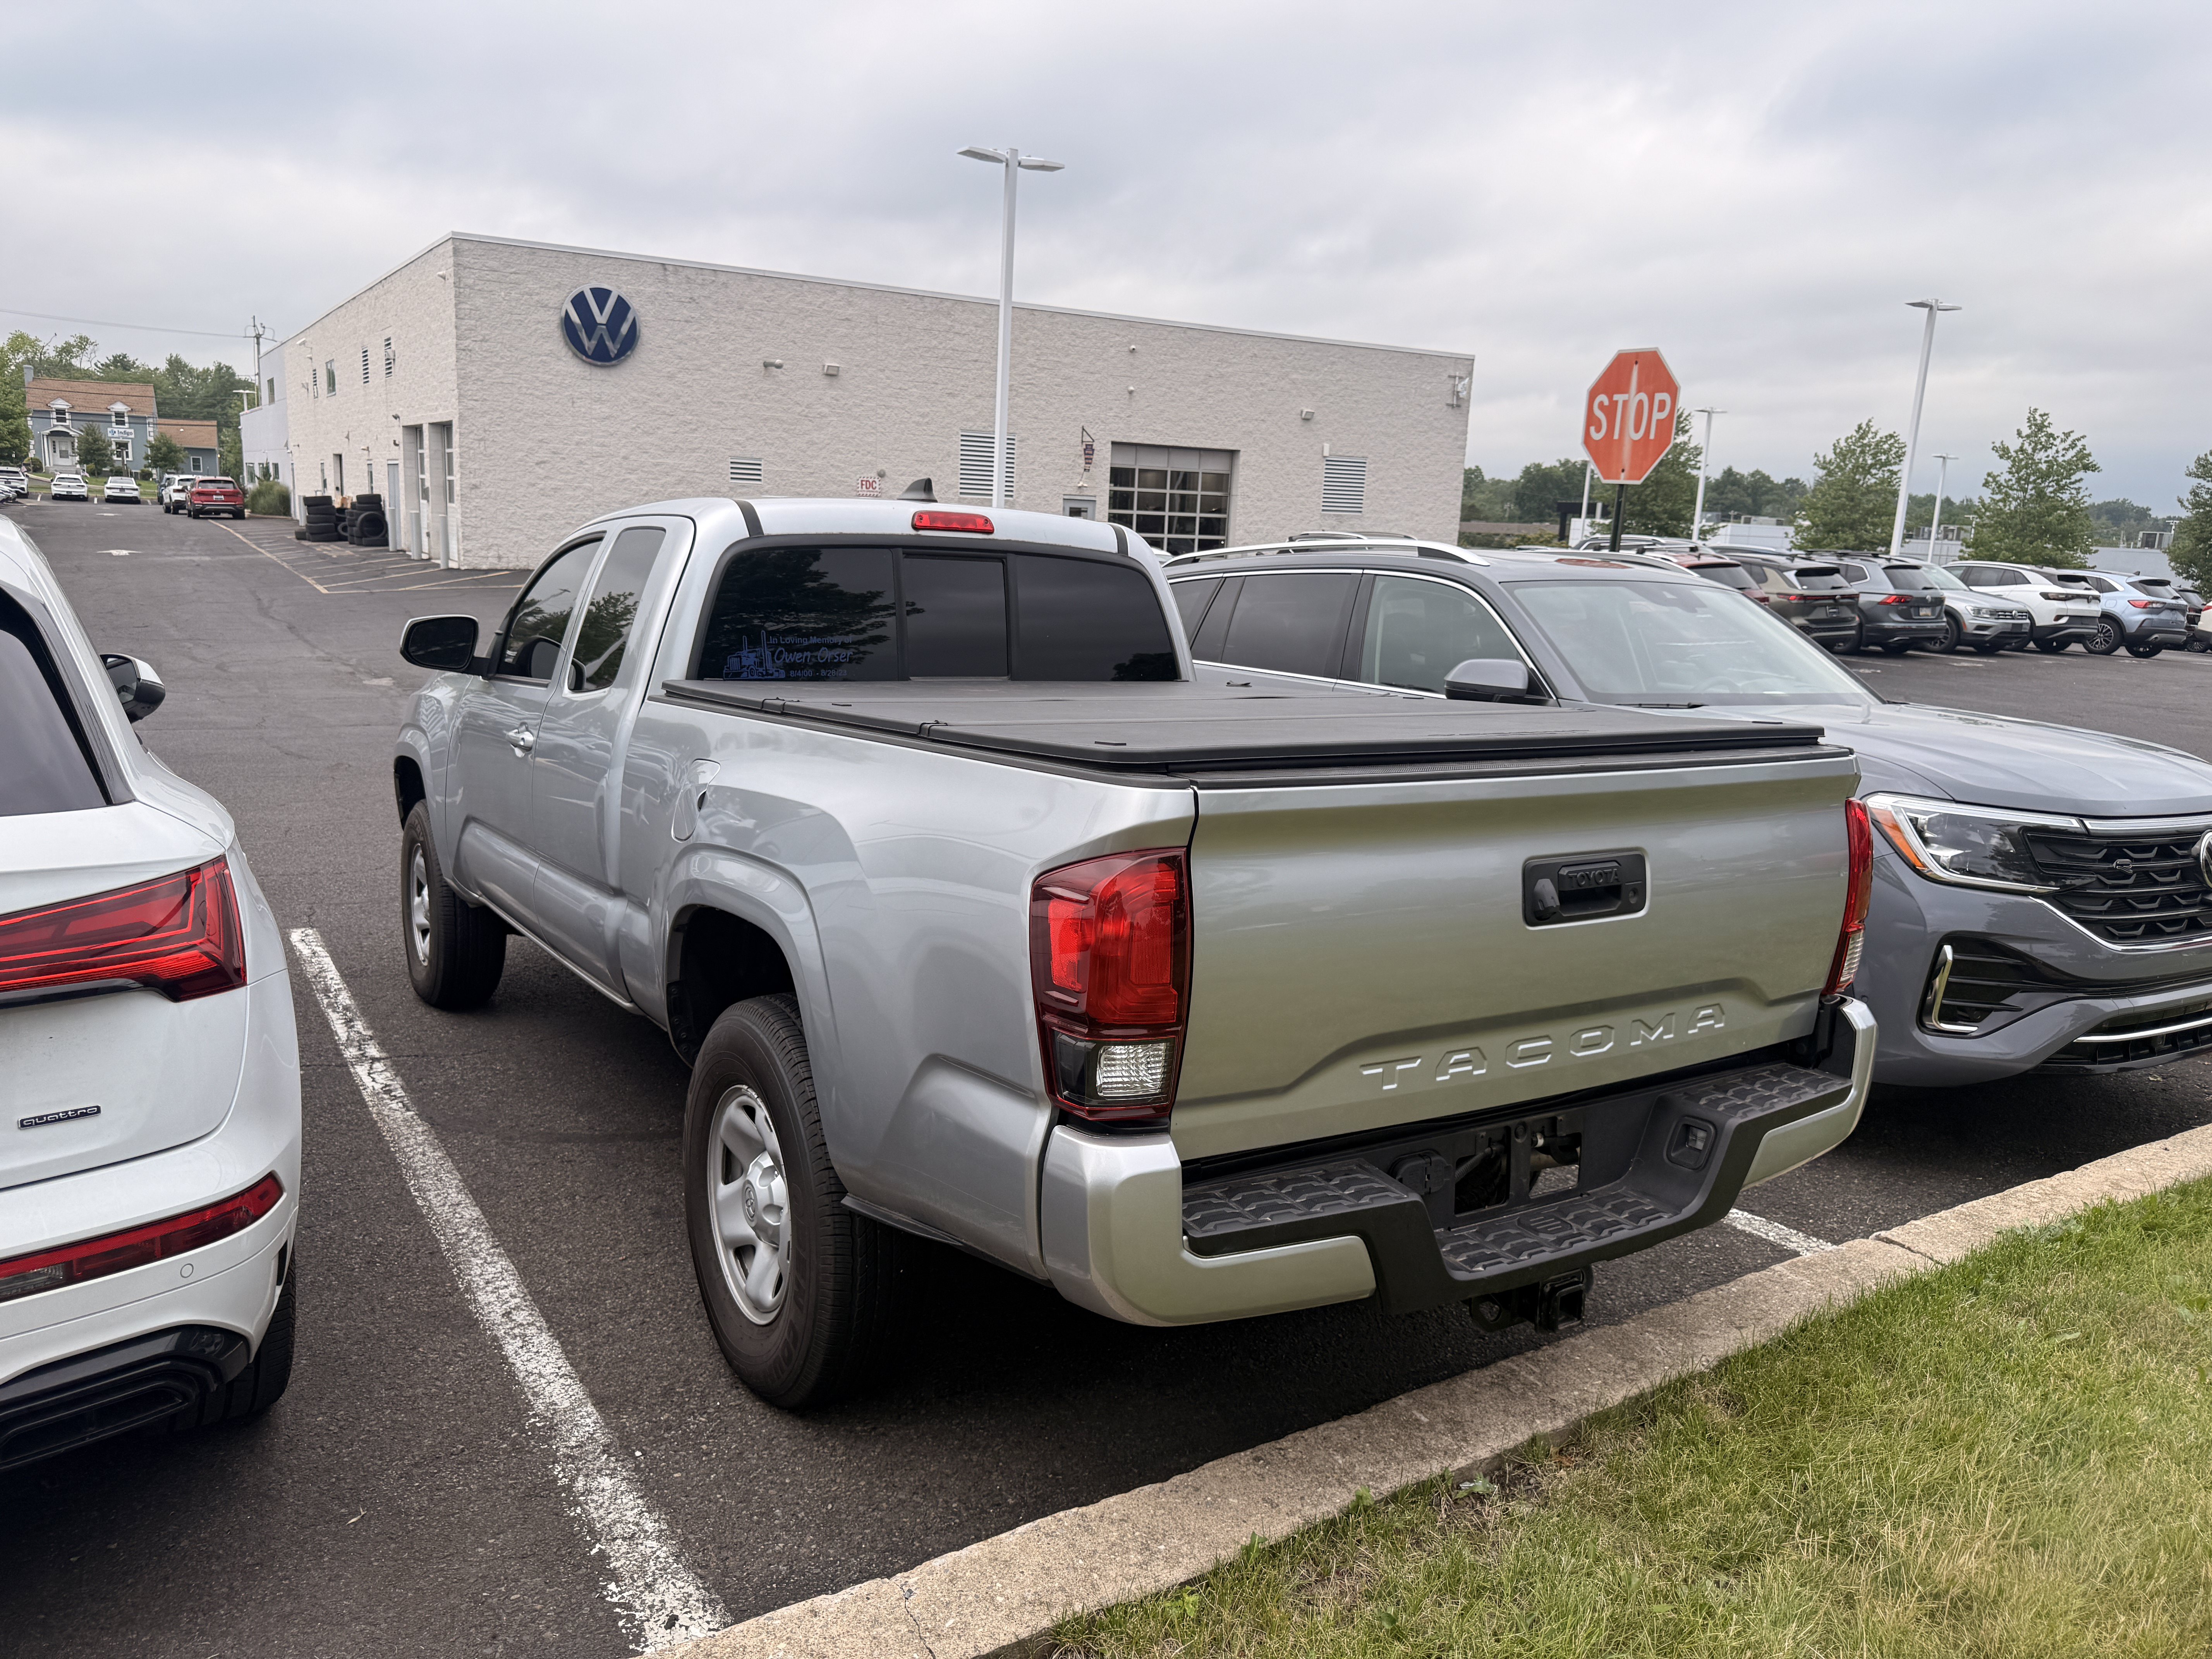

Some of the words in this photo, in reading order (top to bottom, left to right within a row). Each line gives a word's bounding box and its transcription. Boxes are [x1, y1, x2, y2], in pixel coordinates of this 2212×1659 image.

[1589, 392, 1671, 441] STOP
[860, 480, 877, 490] FDC
[780, 636, 808, 645] Loving
[810, 636, 842, 645] Memory
[775, 647, 811, 663] Owen
[817, 647, 853, 663] Orser
[1568, 868, 1621, 888] TOYOTA
[1360, 1003, 1725, 1090] TACOMA
[23, 1107, 97, 1126] quattro
